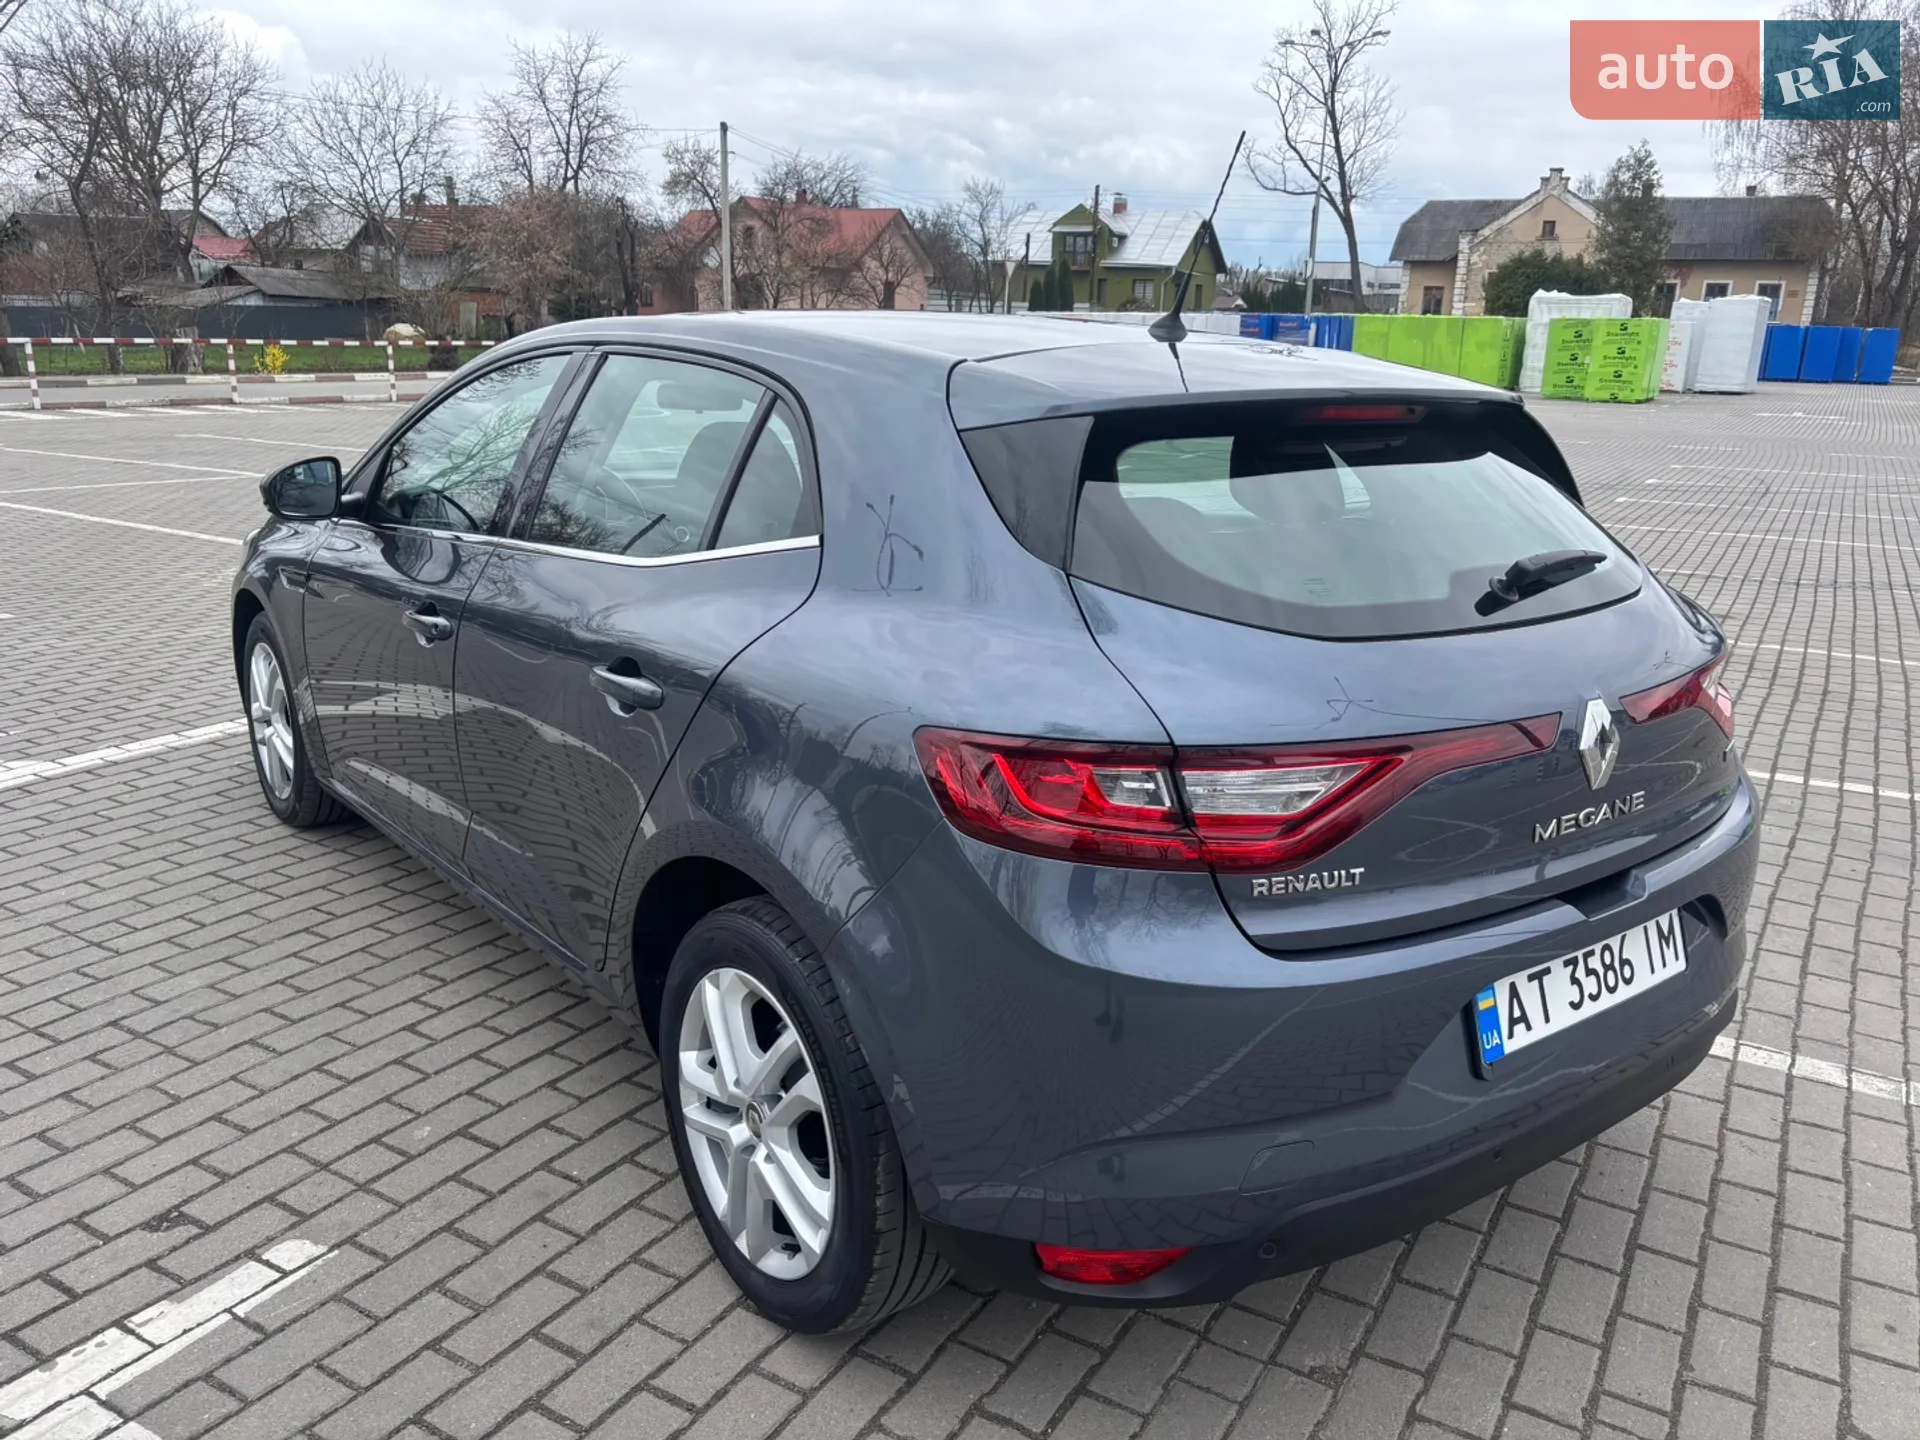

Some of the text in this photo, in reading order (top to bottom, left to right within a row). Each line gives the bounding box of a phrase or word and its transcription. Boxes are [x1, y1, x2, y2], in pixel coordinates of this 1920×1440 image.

[1533, 790, 1646, 844] MEGANE
[1251, 867, 1365, 897] RENAULT
[1506, 919, 1680, 1040] AT 3586 IM
[1483, 1030, 1502, 1049] UA
